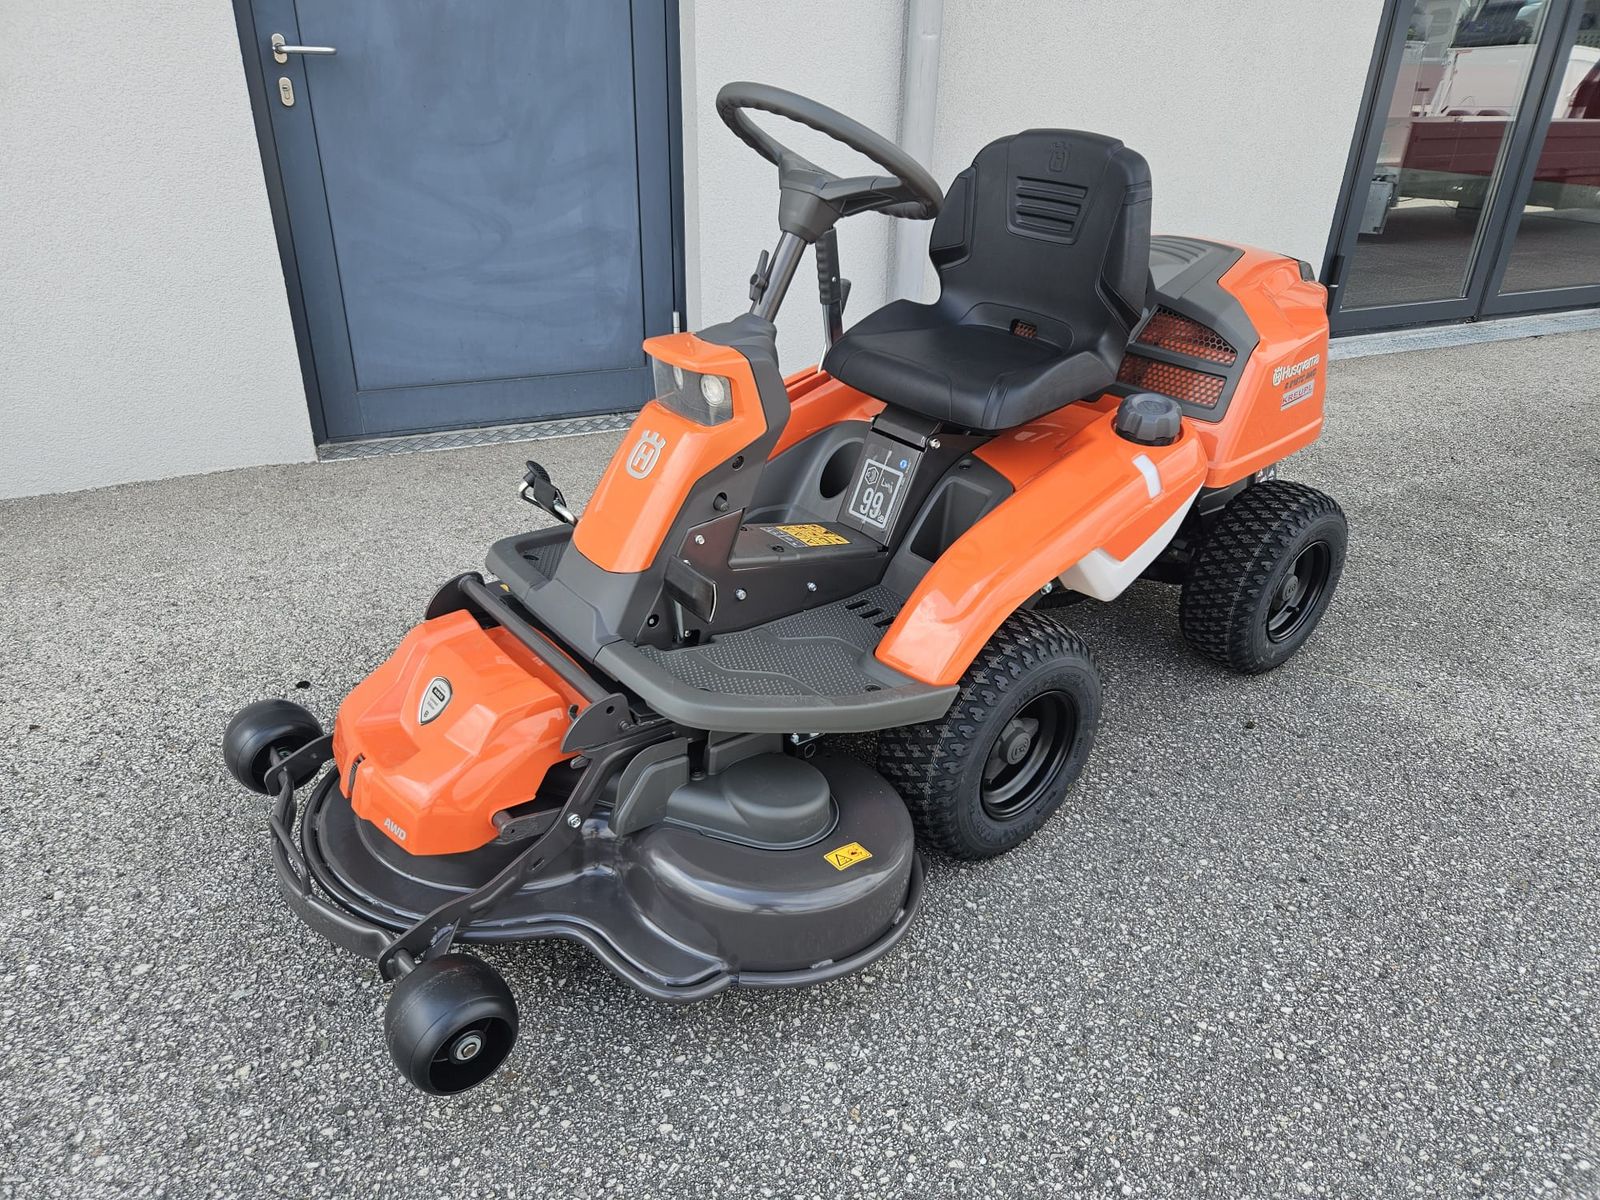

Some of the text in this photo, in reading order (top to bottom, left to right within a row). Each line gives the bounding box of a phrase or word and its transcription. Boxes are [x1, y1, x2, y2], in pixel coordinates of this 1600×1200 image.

[1282, 384, 1313, 403] KREUPL
[860, 487, 884, 519] 99
[384, 817, 407, 841] AWD
